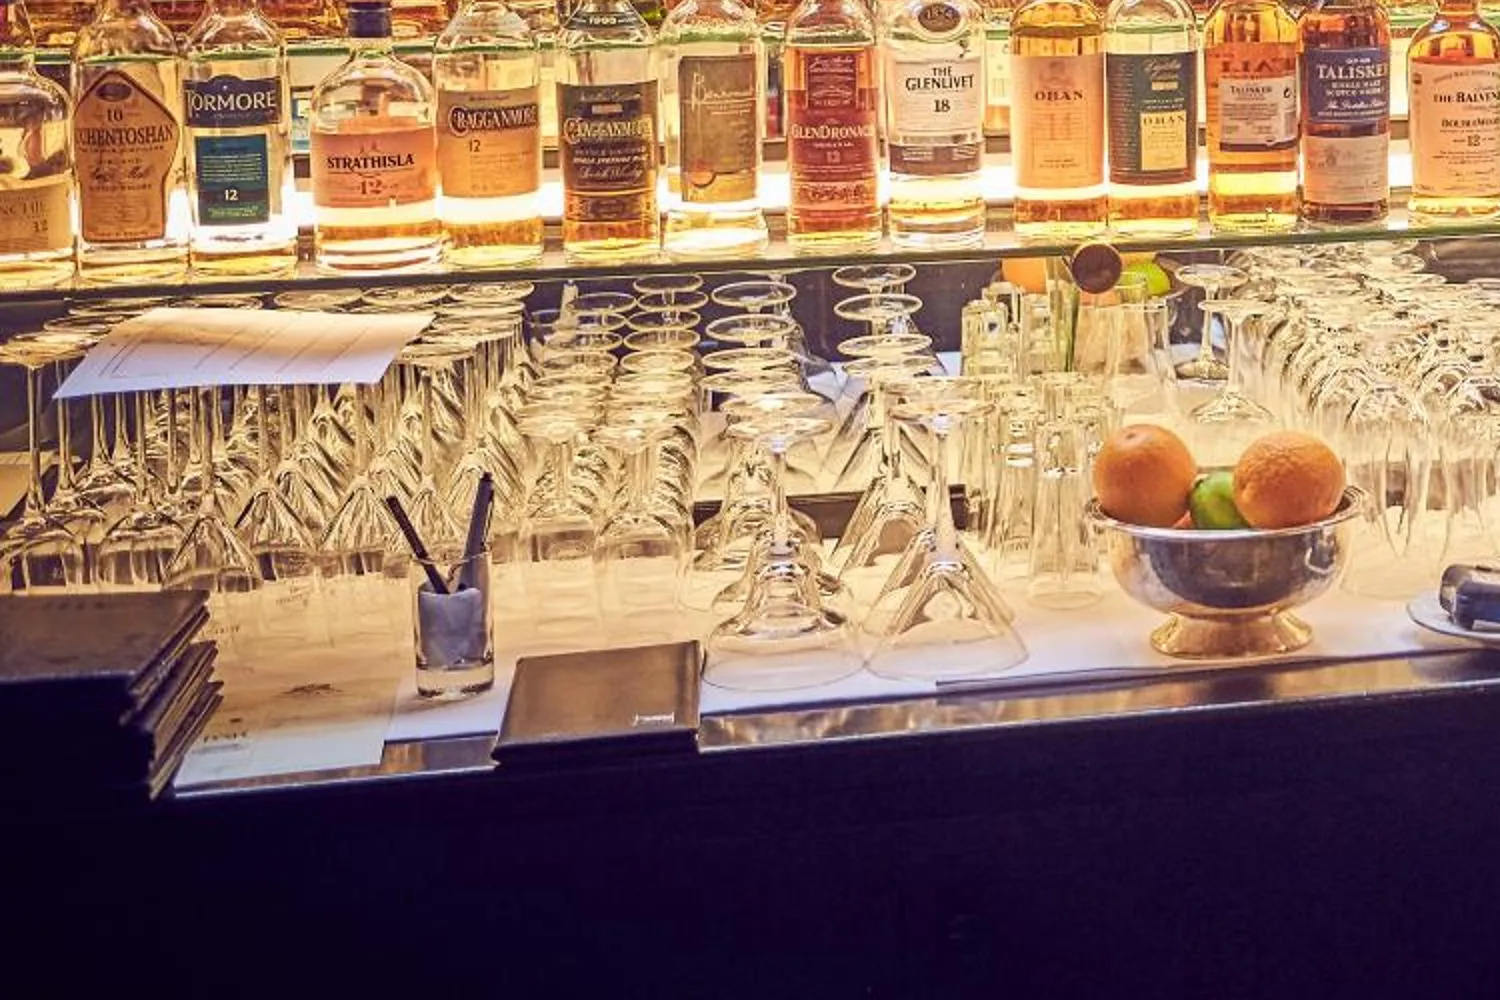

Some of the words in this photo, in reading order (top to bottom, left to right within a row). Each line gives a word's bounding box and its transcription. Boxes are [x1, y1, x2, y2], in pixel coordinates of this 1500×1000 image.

[932, 66, 951, 76] THE
[905, 75, 974, 92] GLENLIVET
[184, 89, 277, 117] TORMORE
[933, 99, 951, 114] 18
[106, 108, 123, 121] 10
[468, 139, 481, 152] 12
[327, 153, 415, 171] STRATHISLA
[223, 189, 239, 201] 12
